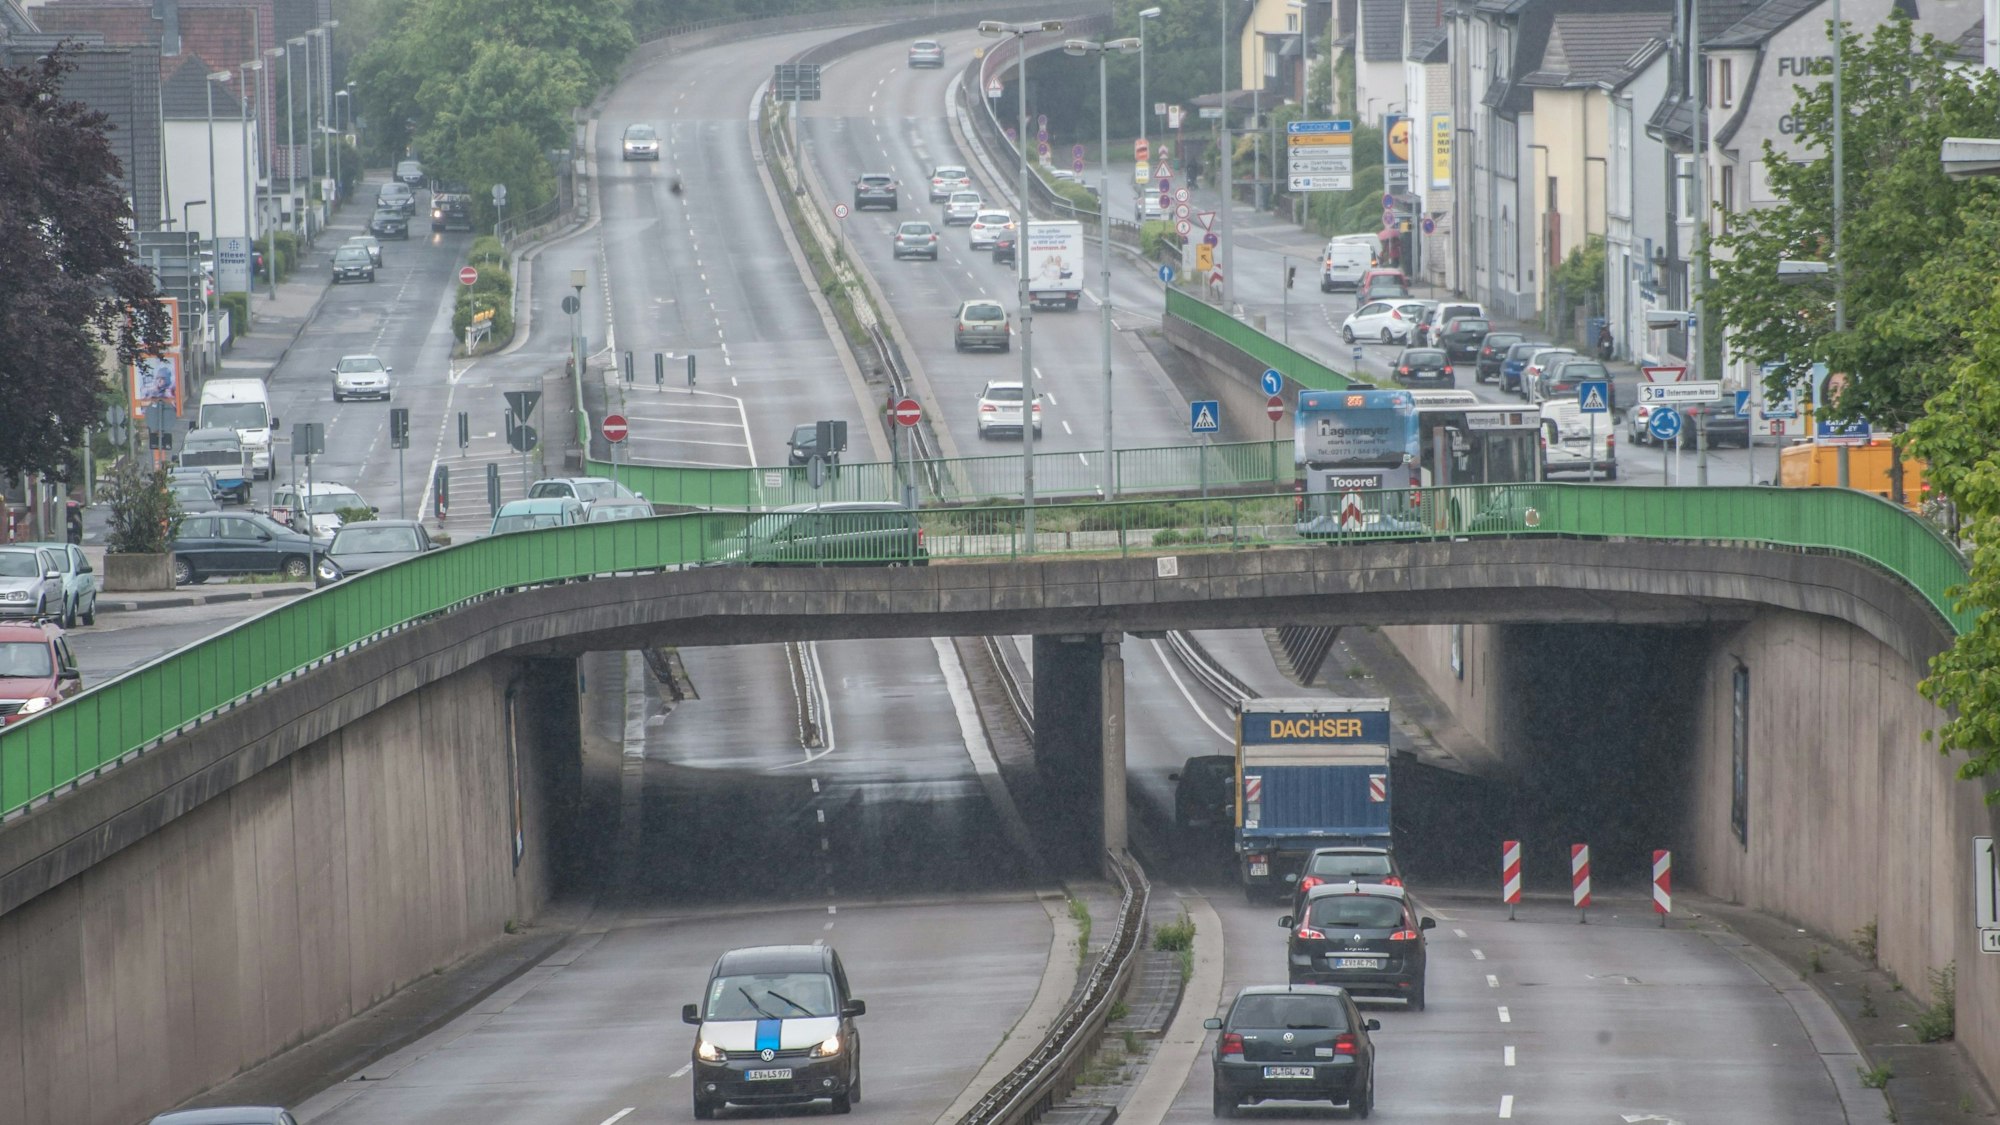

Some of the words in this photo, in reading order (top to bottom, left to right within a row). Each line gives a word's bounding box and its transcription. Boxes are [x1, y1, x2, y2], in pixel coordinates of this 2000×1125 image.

[1317, 419, 1389, 437] hagemeyer
[1331, 476, 1377, 487] Tooore!
[1270, 719, 1362, 738] DACHSER
[750, 1071, 763, 1079] LEV
[1300, 1068, 1310, 1076] 42
